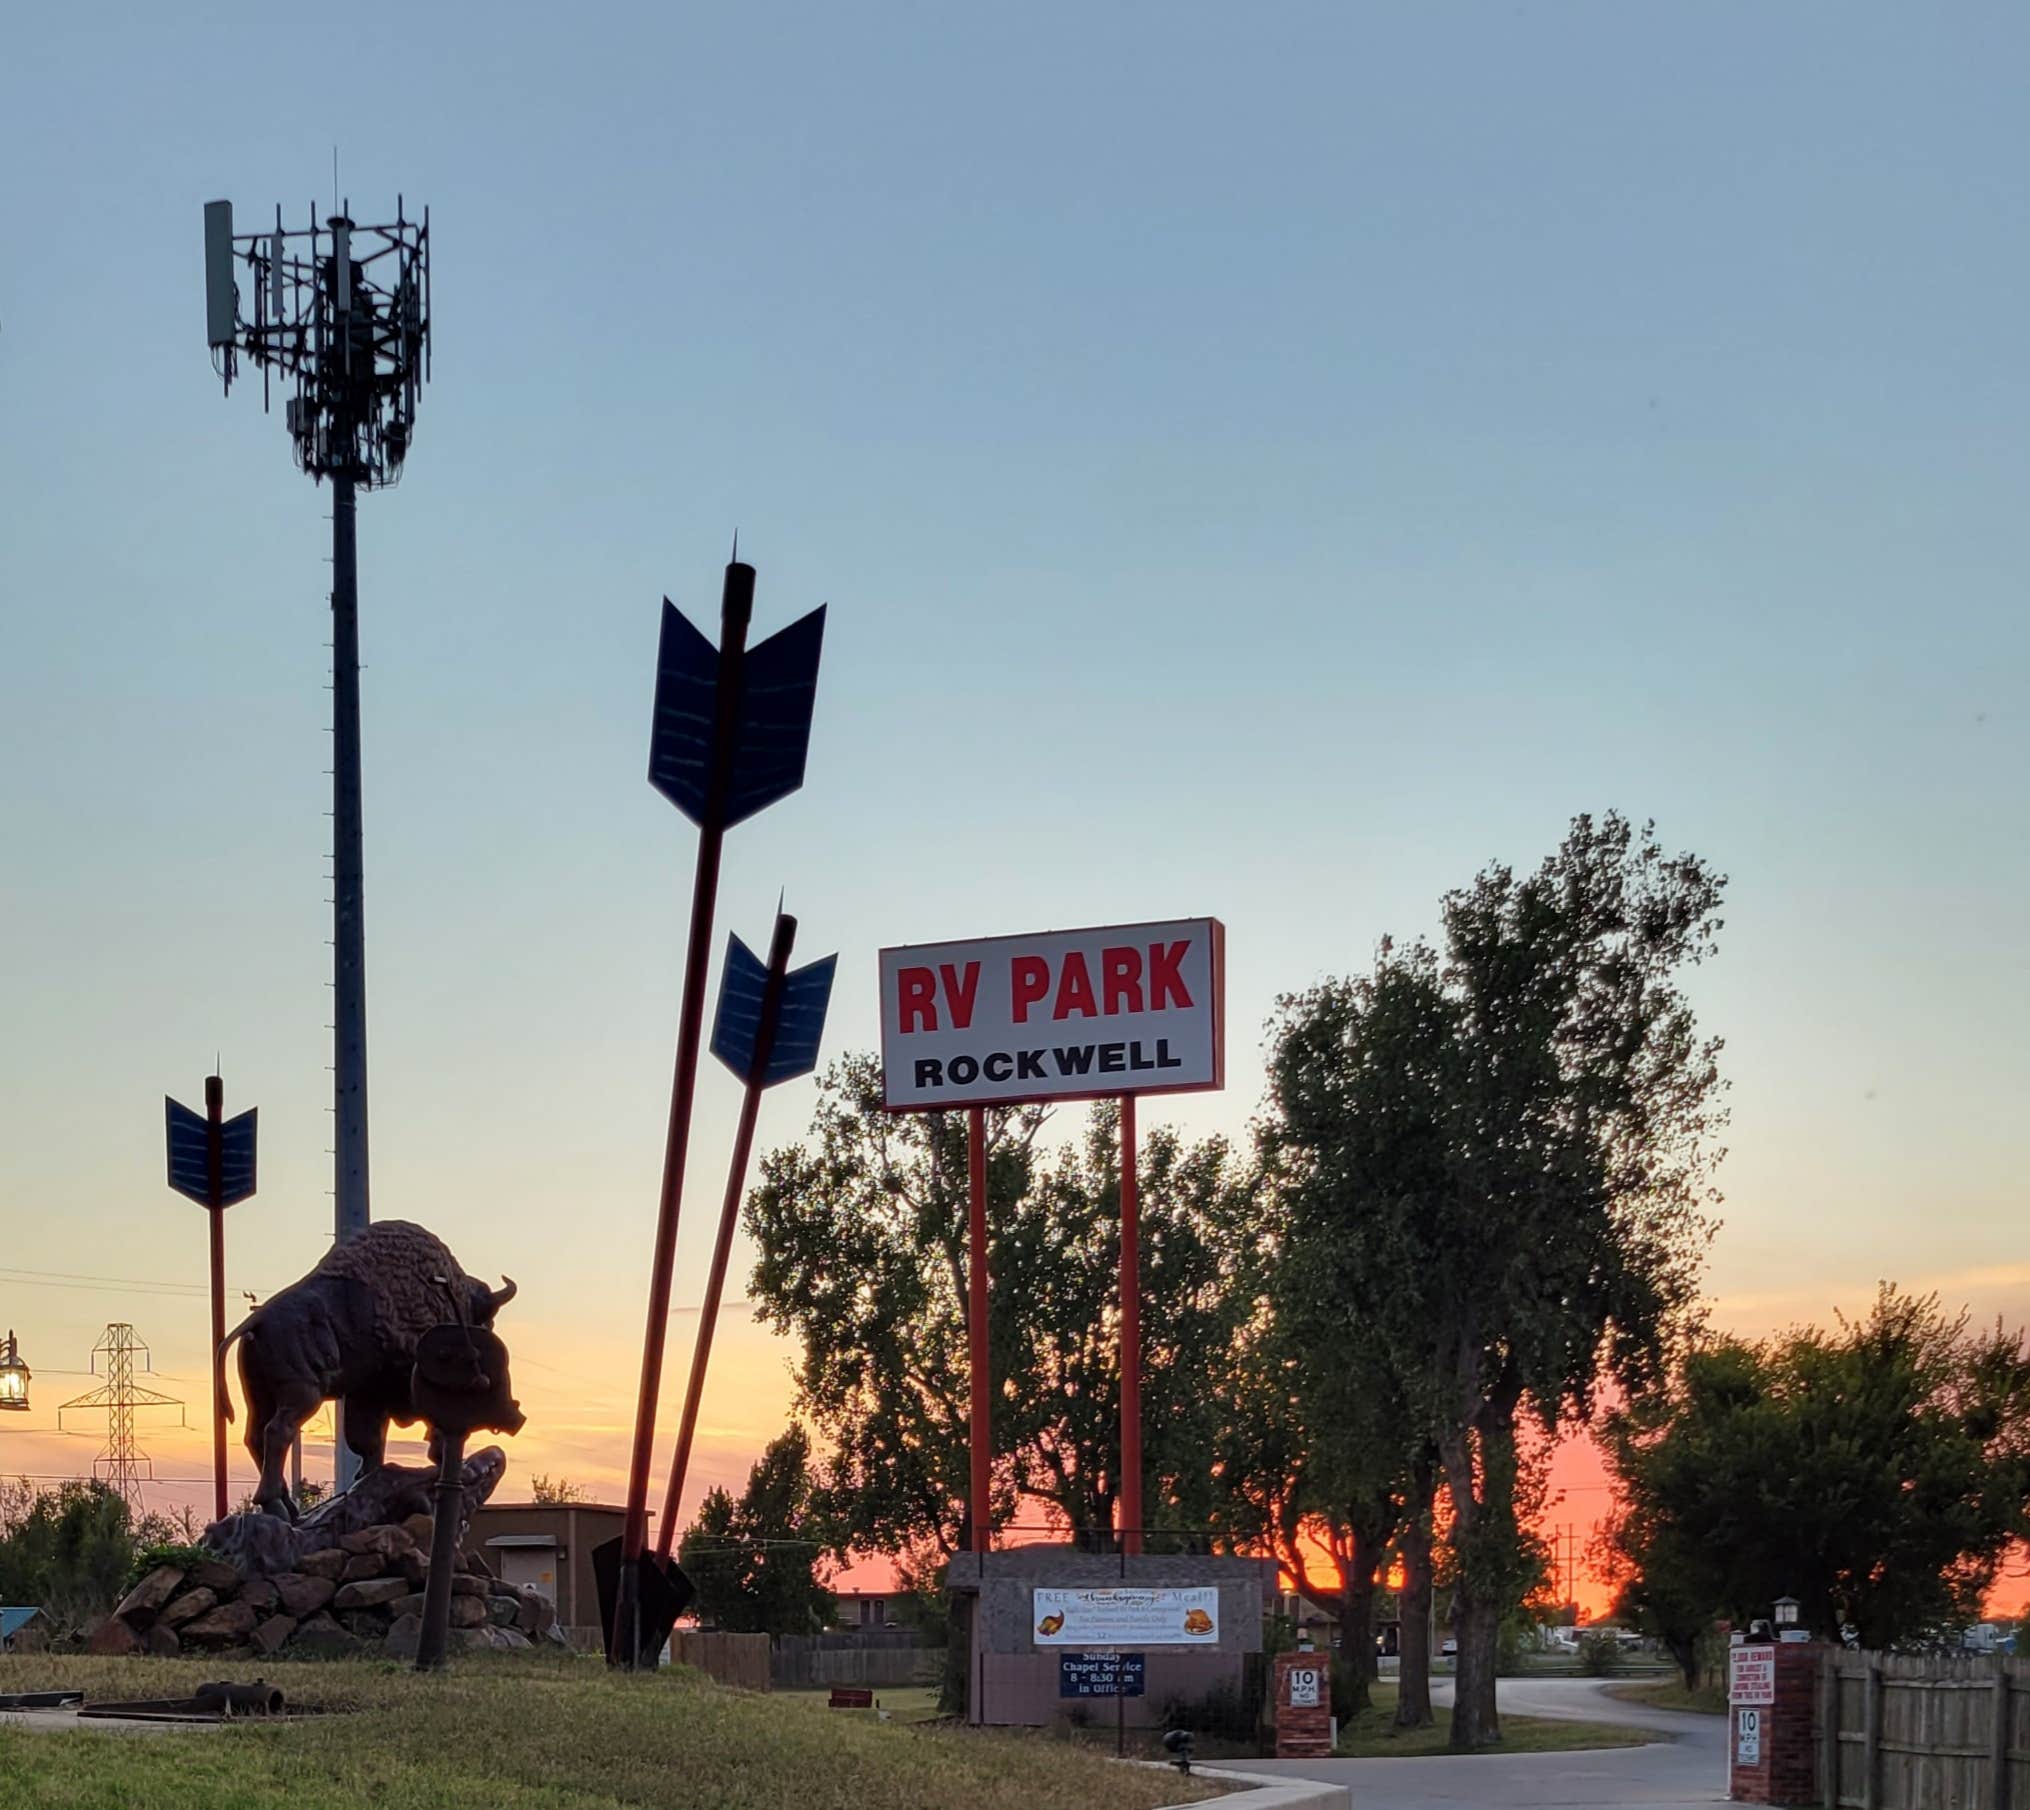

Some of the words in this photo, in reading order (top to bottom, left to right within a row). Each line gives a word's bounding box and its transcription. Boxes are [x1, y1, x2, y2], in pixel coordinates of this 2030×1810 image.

[897, 961, 981, 1035] RV
[1011, 939, 1195, 1024] PARK
[914, 1038, 1182, 1088] ROCKWELL
[1037, 1592, 1069, 1603] FREE
[1083, 1653, 1121, 1663] Sunday
[1063, 1662, 1098, 1673] Chapel
[1070, 1673, 1078, 1682] 8
[1090, 1673, 1113, 1682] 8:30
[1295, 1671, 1314, 1684] 10
[1079, 1683, 1090, 1693] in
[1741, 1712, 1756, 1731] 10
